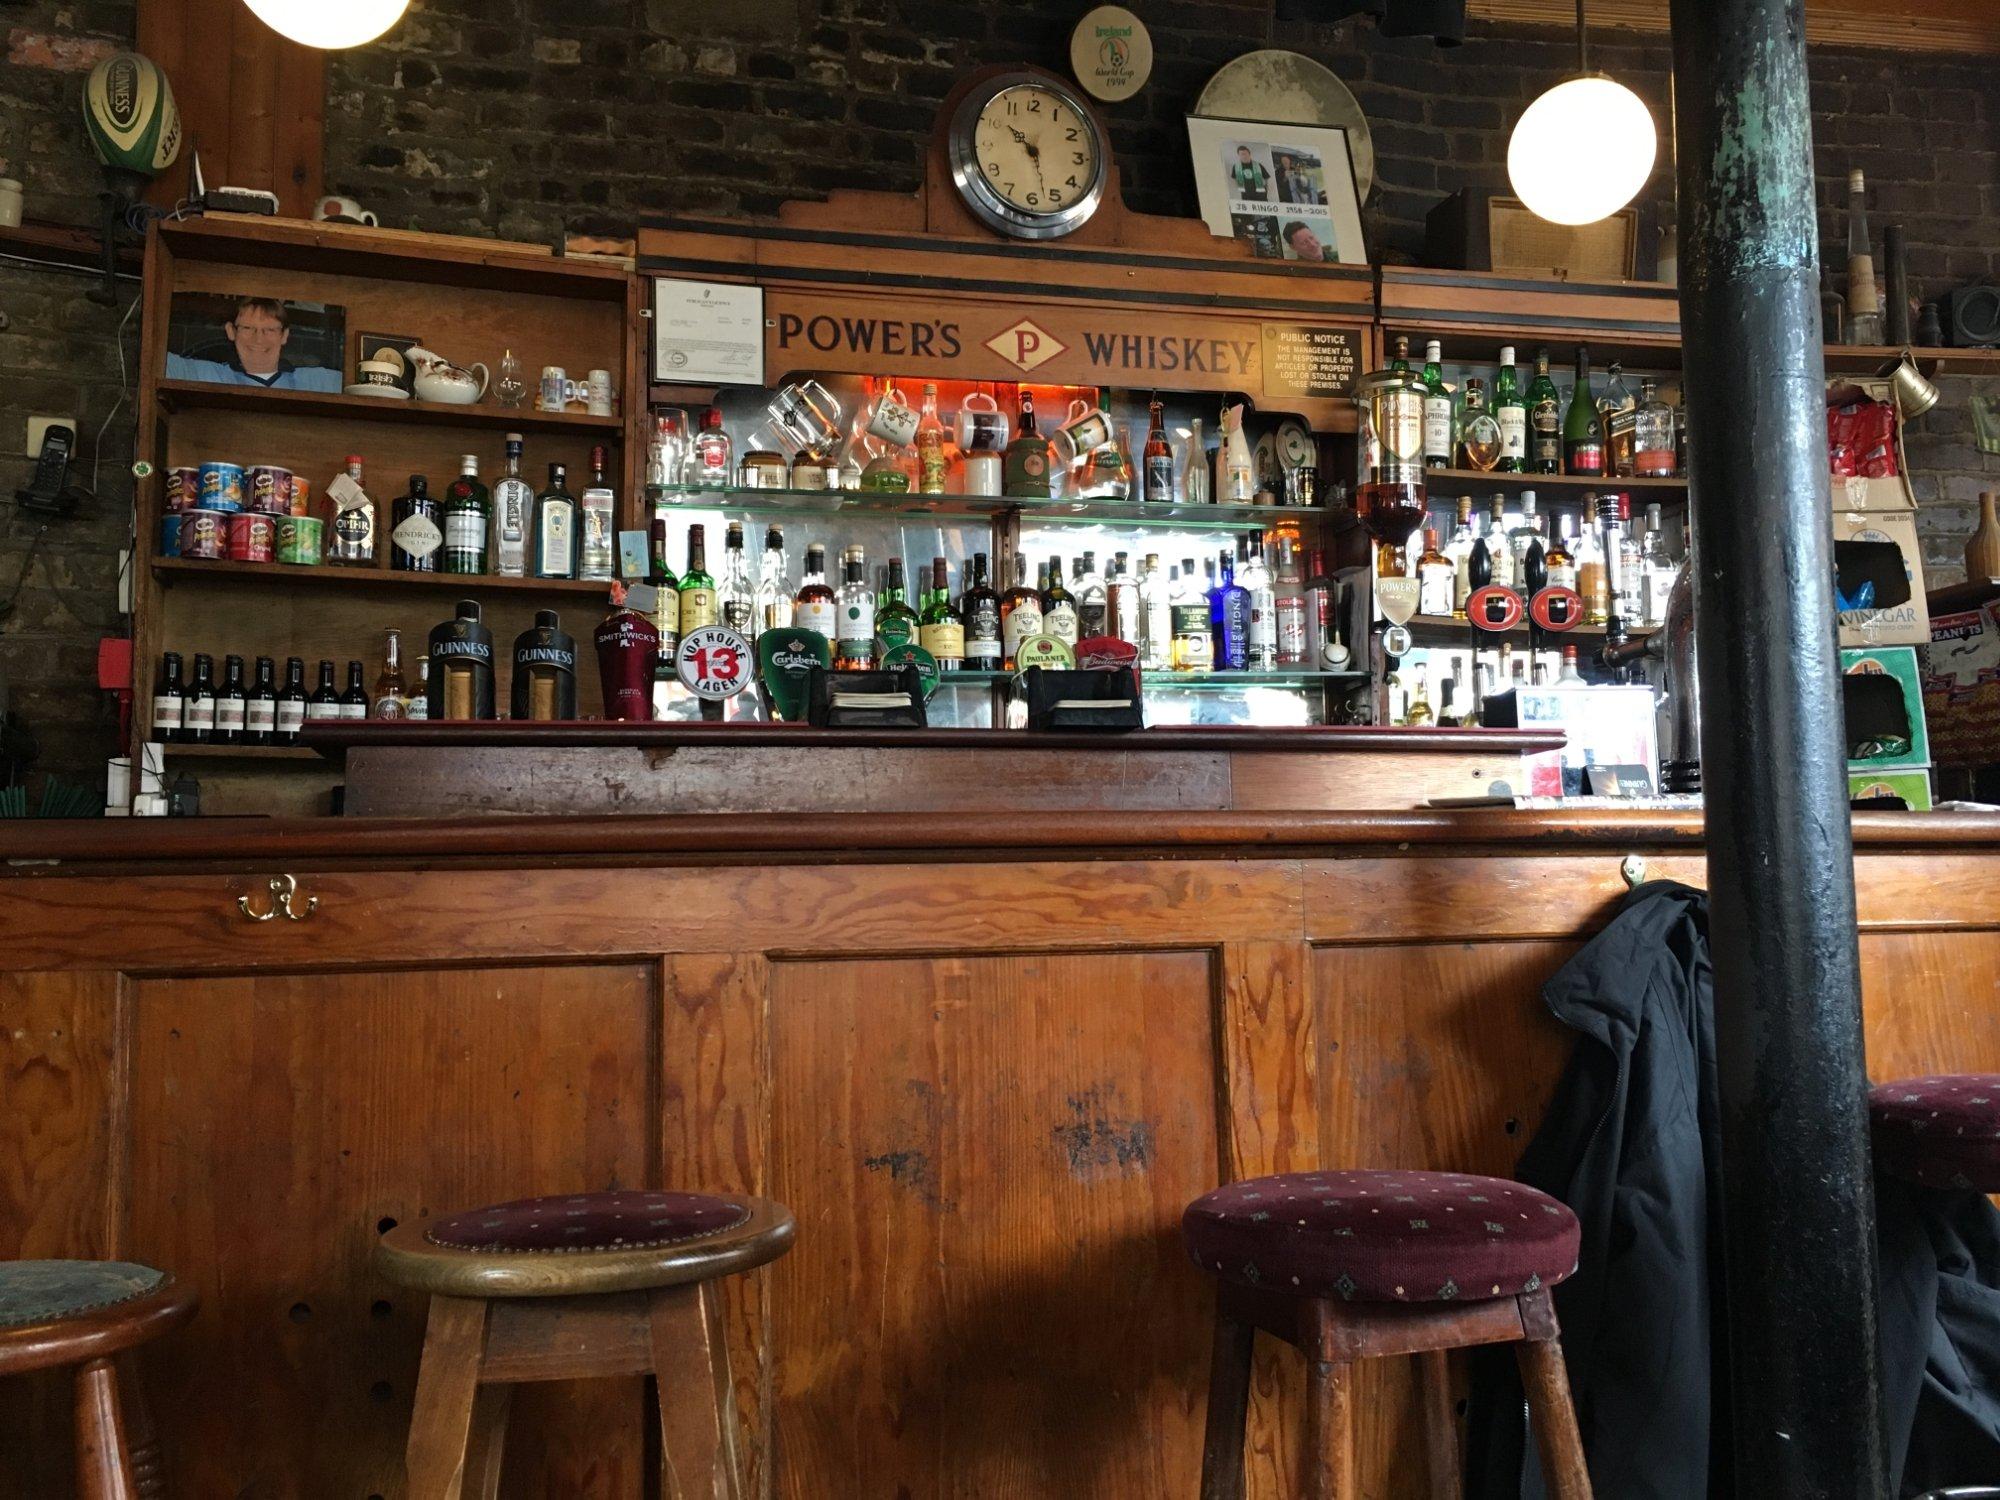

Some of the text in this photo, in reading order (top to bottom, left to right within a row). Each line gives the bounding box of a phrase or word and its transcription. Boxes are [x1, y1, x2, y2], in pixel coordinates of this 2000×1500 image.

[1095, 25, 1132, 37] Ireland
[1095, 66, 1135, 79] World Cup
[114, 62, 132, 114] GUINNESS
[1007, 101, 1018, 116] 11
[1026, 100, 1041, 113] 12
[1053, 108, 1058, 122] 1
[988, 118, 1001, 129] 10
[1065, 128, 1078, 142] 2
[1072, 152, 1085, 165] 3
[988, 163, 1000, 177] 8
[1065, 175, 1077, 189] 4
[1003, 182, 1015, 196] 7
[1048, 189, 1062, 202] 5
[1026, 192, 1039, 206] 6
[1252, 203, 1279, 213] RINGO
[778, 313, 961, 358] POWER'S
[1082, 332, 1255, 375] WHISKEY
[1280, 333, 1345, 344] PUBLIC NOTICE
[1278, 345, 1350, 356] THE MANAGEMENT IS
[1293, 355, 1337, 364] RESPONSIBLE
[1275, 363, 1353, 373] ARTICLES OR PROPERTY
[1280, 371, 1297, 379] LOST
[1312, 373, 1337, 381] STOLEN
[1288, 380, 1308, 388] THESE
[506, 482, 520, 528] DINGLE
[336, 518, 369, 531] OPIHR
[1380, 582, 1418, 594] POWERS
[972, 613, 999, 624] TEELING
[1014, 612, 1040, 622] TEELING
[1050, 615, 1076, 625] TEELING
[1844, 607, 1917, 624] VINEGAR
[599, 632, 656, 644] SMITHWICK'S
[432, 641, 490, 658] GUINNESS
[683, 633, 747, 663] HOP HOUSE
[517, 648, 574, 665] GUINNESS
[1026, 654, 1066, 663] PAULANER
[693, 647, 740, 680] 13
[695, 677, 739, 692] LAGER
